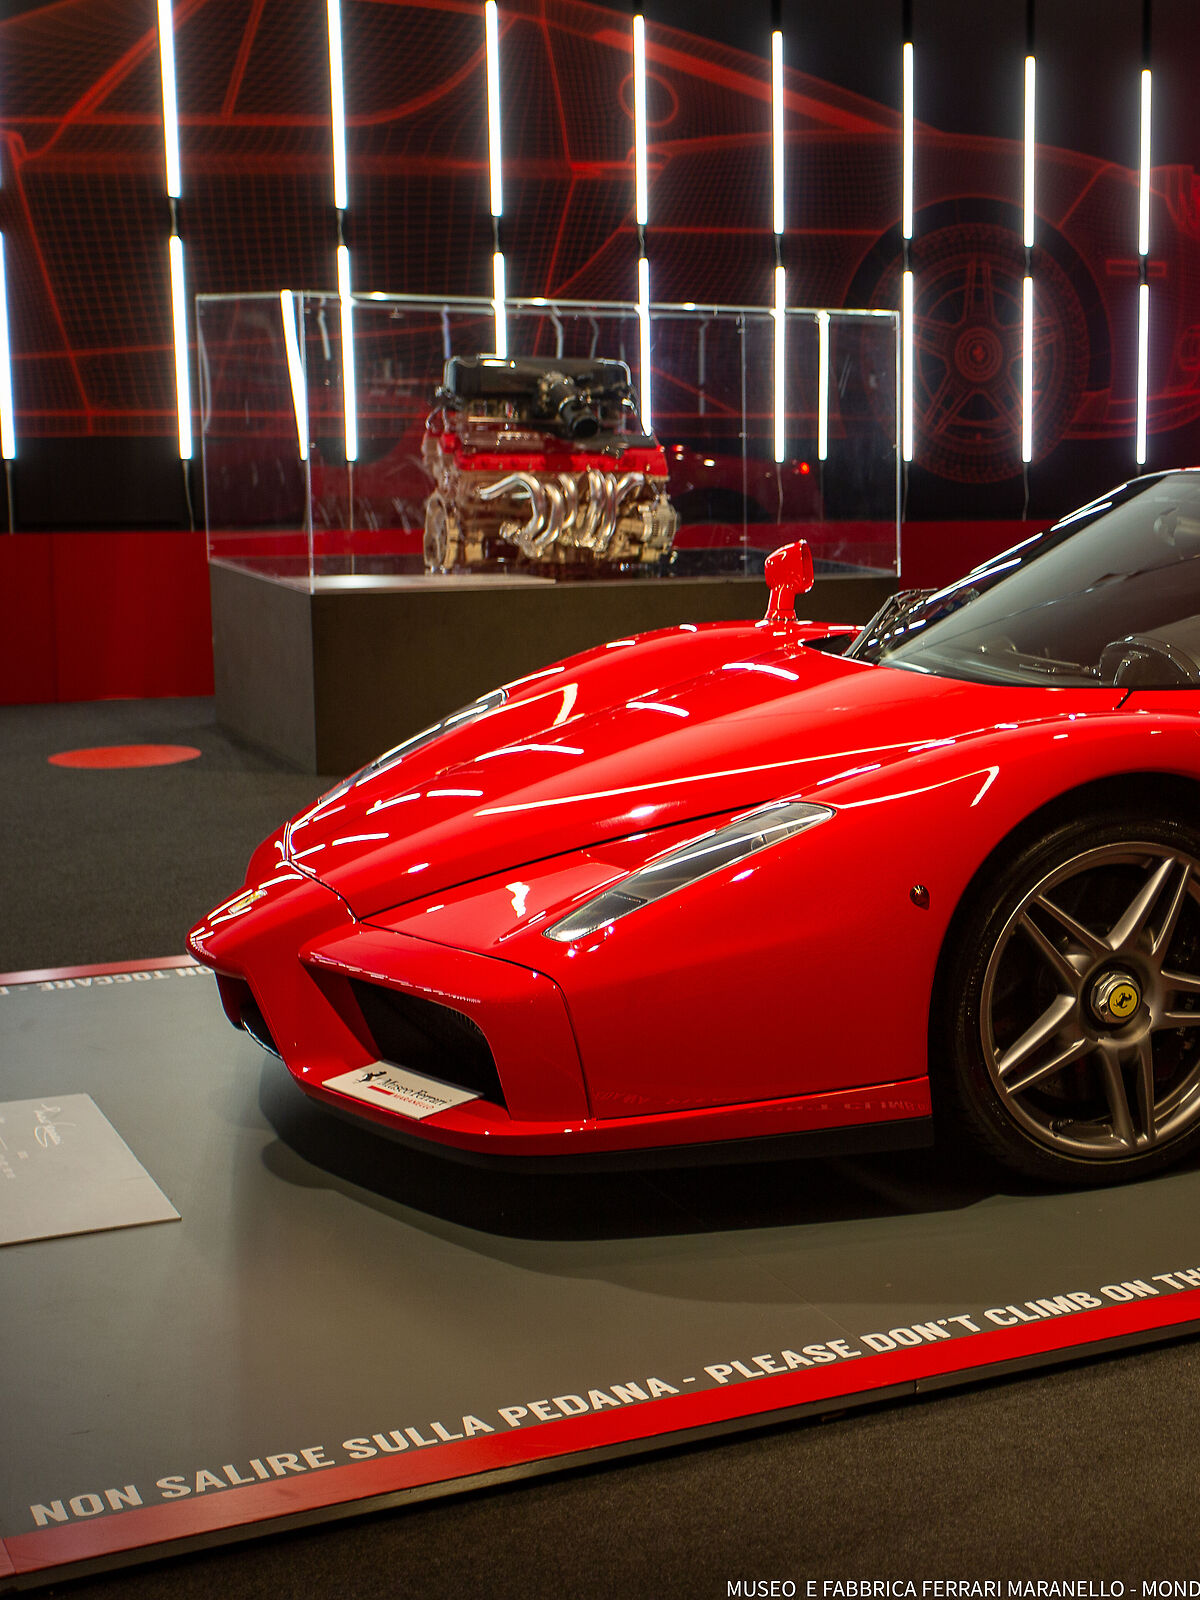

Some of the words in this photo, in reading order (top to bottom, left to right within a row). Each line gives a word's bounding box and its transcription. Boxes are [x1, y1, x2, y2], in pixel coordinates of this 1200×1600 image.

[36, 970, 171, 992] TOCCARE
[413, 1088, 448, 1107] Ferrari
[29, 1484, 144, 1527] NON
[156, 1445, 336, 1498] SALIRE
[341, 1414, 495, 1461] SULLA
[498, 1376, 680, 1429] PEDANA
[703, 1338, 862, 1384] PLEASE
[859, 1314, 981, 1353] DON'T
[983, 1291, 1103, 1327] CLIMB
[1100, 1279, 1160, 1301] ON
